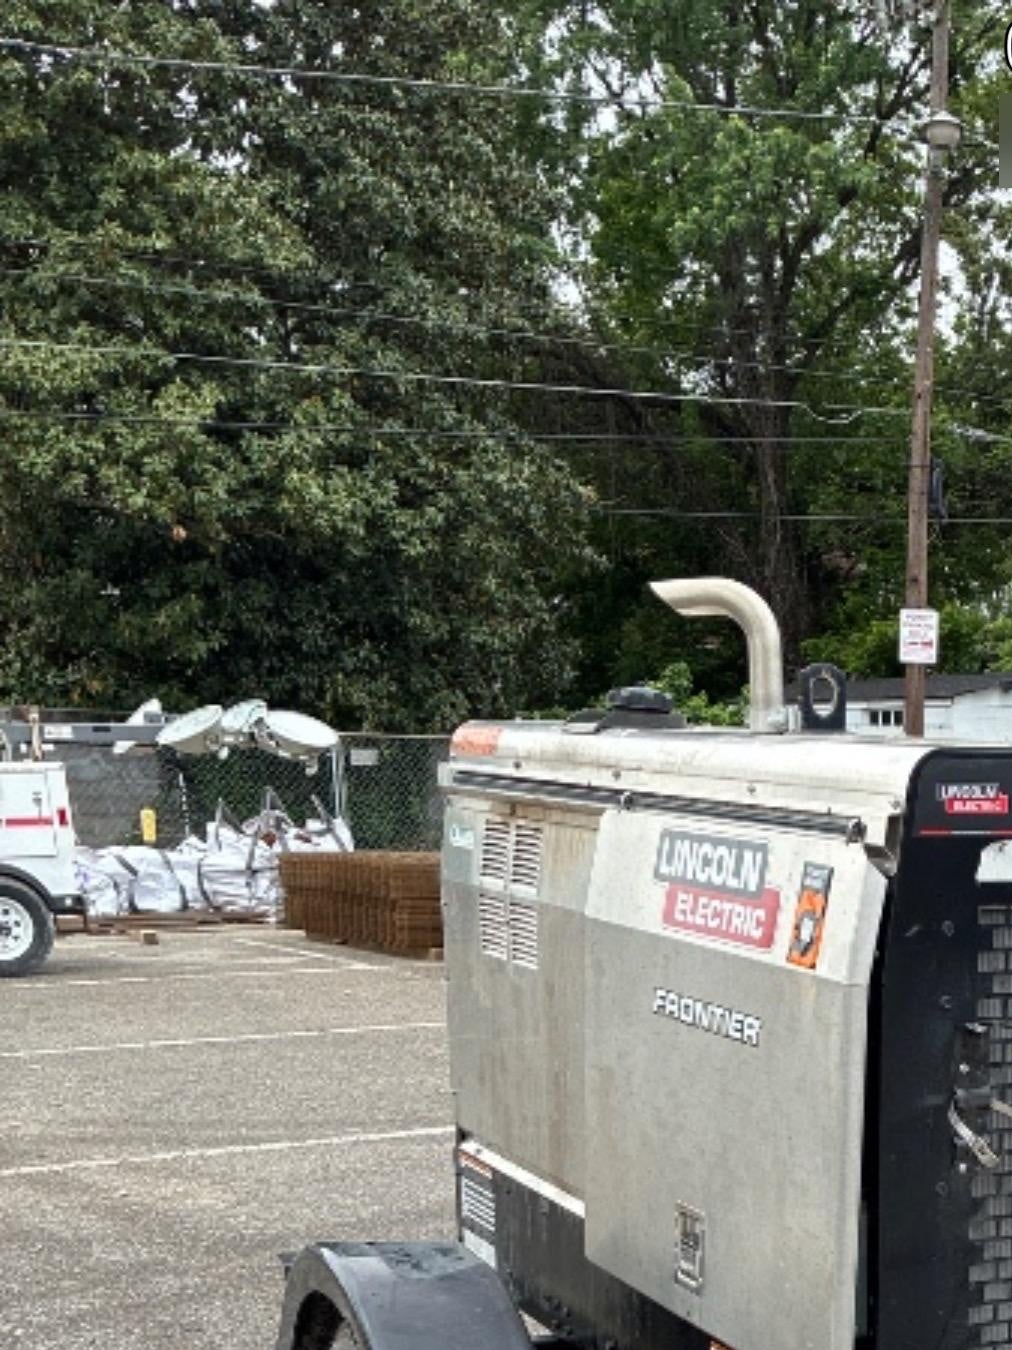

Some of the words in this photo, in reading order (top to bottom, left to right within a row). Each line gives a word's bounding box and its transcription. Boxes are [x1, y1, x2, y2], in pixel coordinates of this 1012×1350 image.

[658, 836, 763, 892] LINCOLN
[673, 890, 766, 939] ELECTRIC
[653, 986, 762, 1047] FRONTIER
